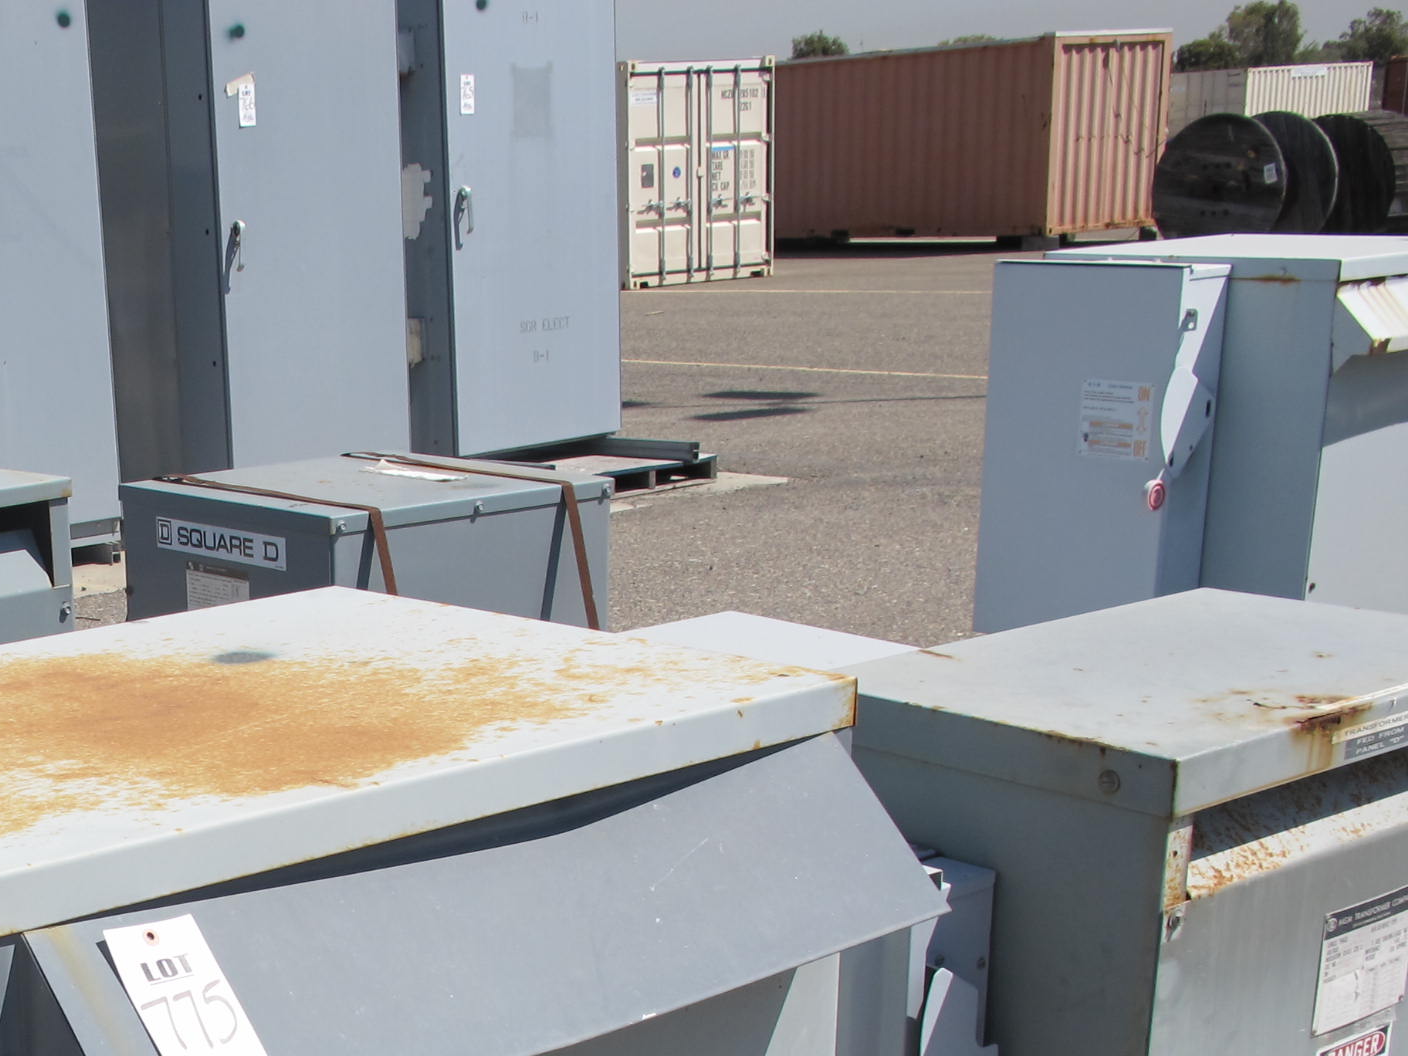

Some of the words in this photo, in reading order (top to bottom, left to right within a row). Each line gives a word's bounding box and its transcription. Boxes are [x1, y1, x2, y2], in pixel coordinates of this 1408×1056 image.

[177, 526, 254, 558] SQUARE
[262, 541, 279, 562] D
[1356, 742, 1384, 755] PANEL
[140, 953, 193, 983] LOT
[140, 979, 238, 1050] 775
